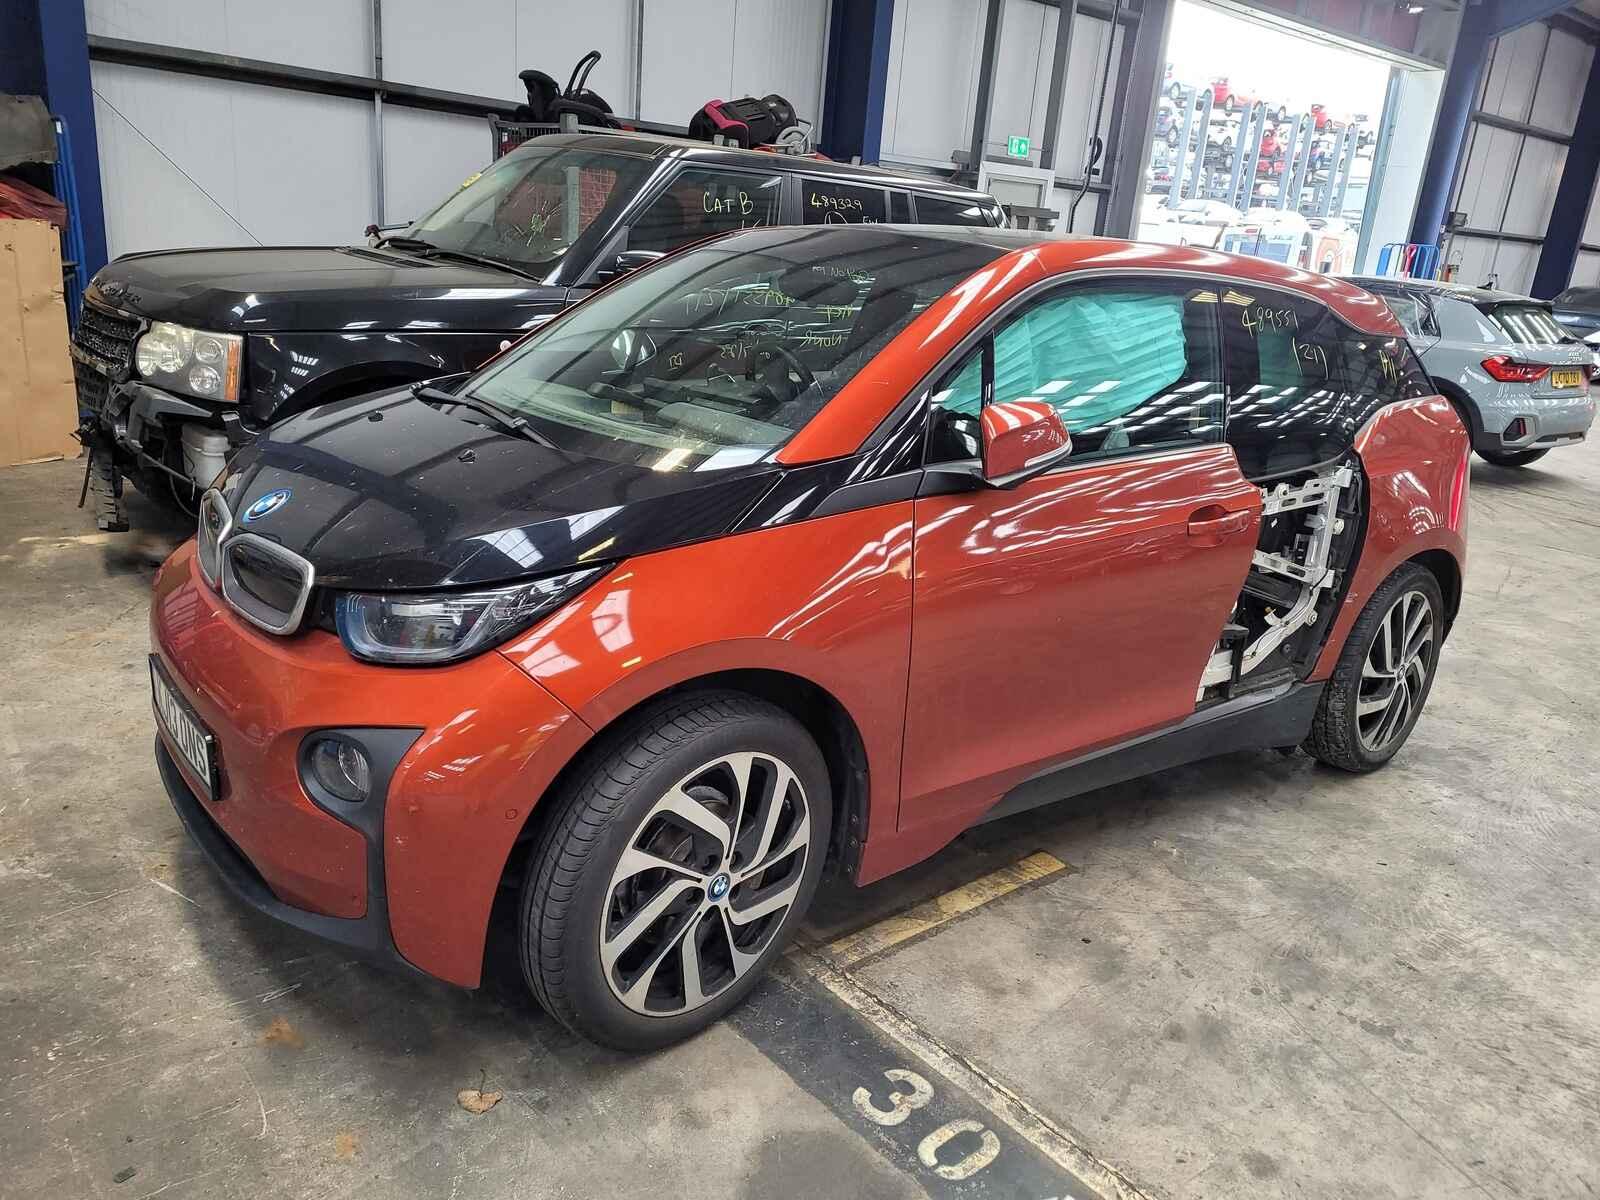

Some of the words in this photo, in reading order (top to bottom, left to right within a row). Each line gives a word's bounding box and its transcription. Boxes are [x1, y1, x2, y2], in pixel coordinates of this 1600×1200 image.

[703, 192, 733, 214] CAT
[739, 191, 753, 215] B
[811, 192, 863, 211] 489329
[1241, 306, 1299, 339] 489551
[852, 1068, 1075, 1200] 30
